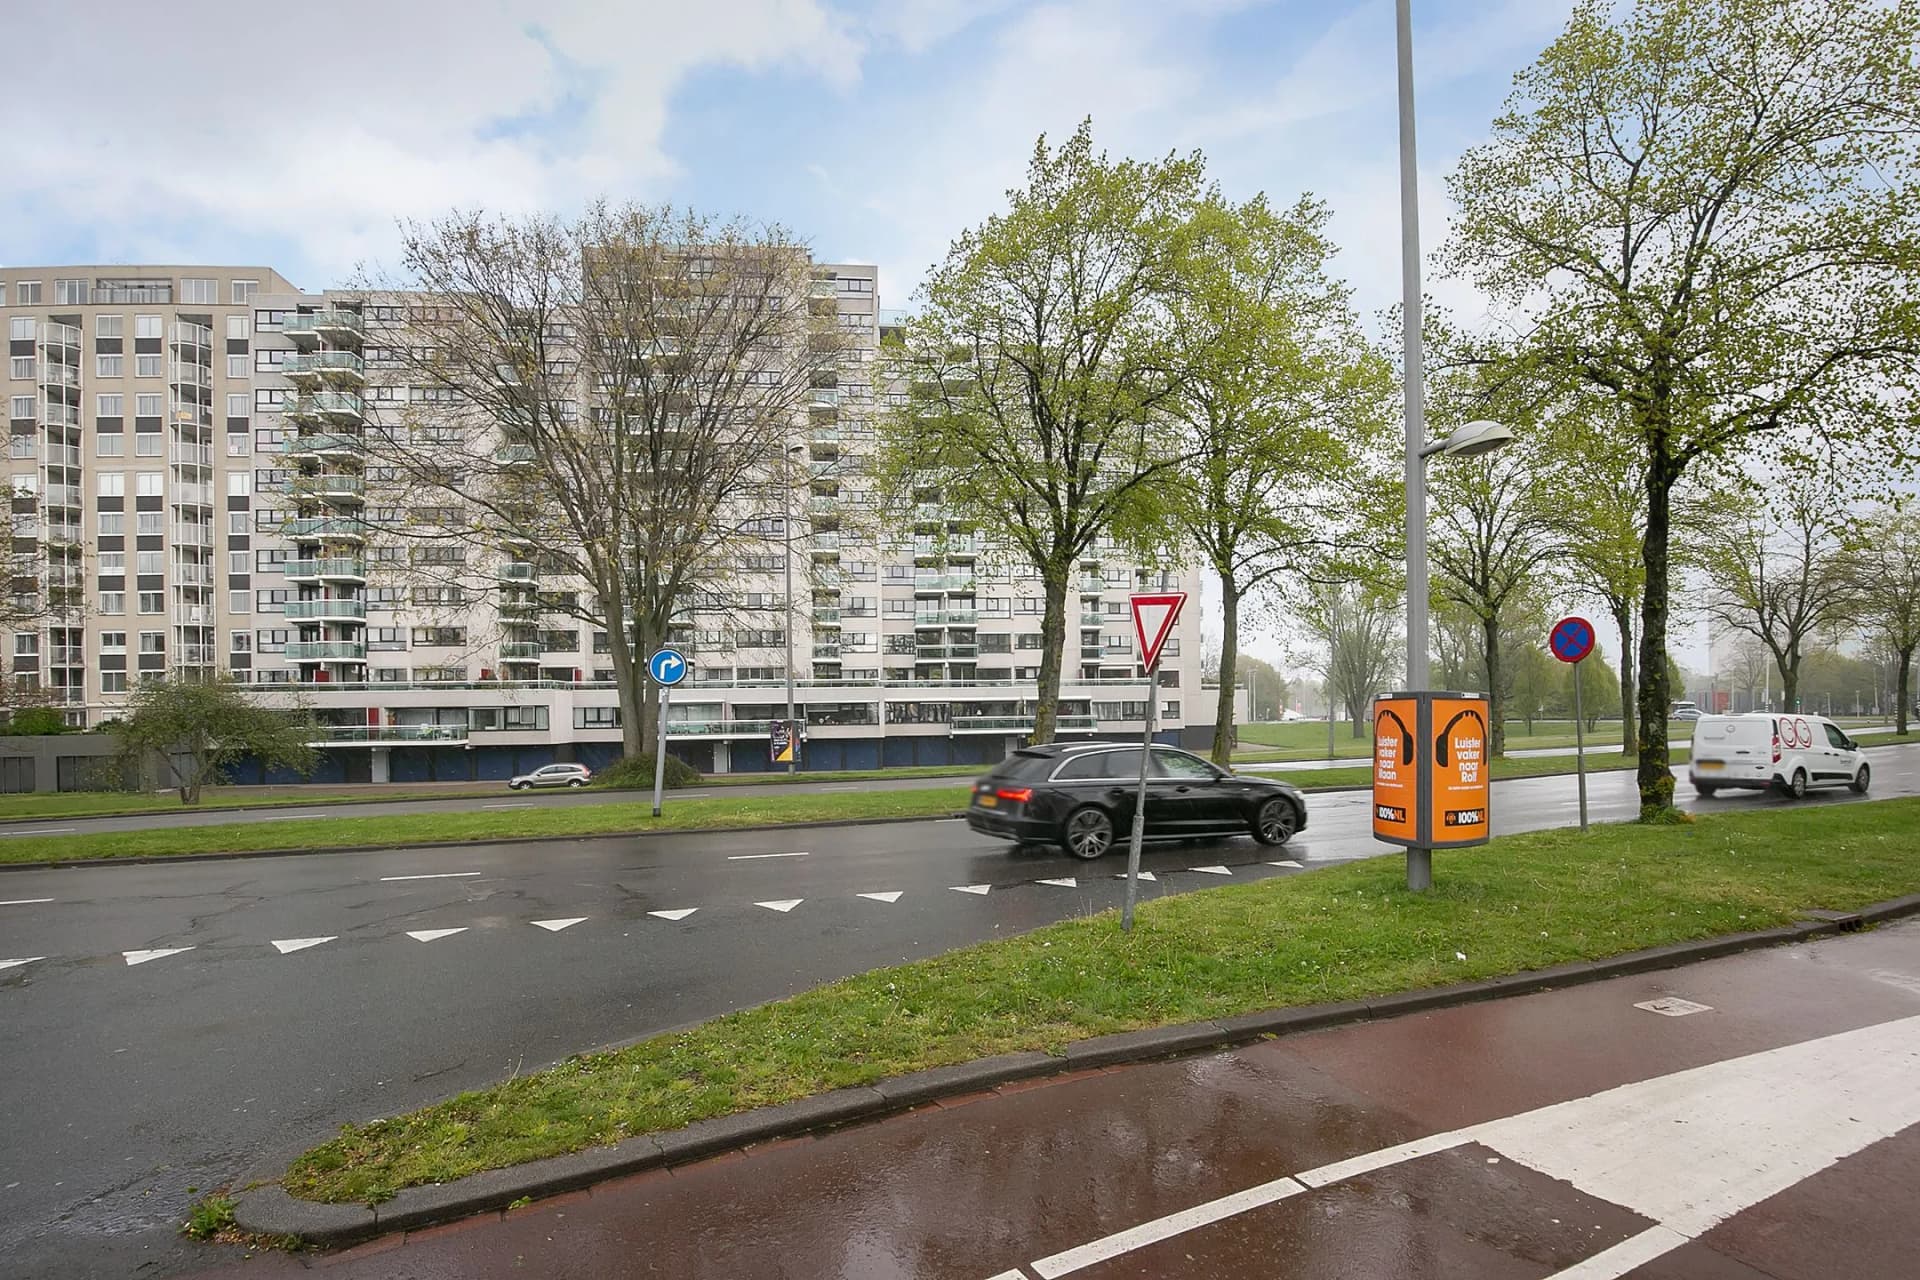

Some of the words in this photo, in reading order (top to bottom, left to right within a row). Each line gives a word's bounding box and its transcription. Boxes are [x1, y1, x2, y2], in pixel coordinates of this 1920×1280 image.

[1454, 737, 1480, 749] Luister
[1456, 749, 1480, 760] vaker
[1459, 762, 1478, 771] naar
